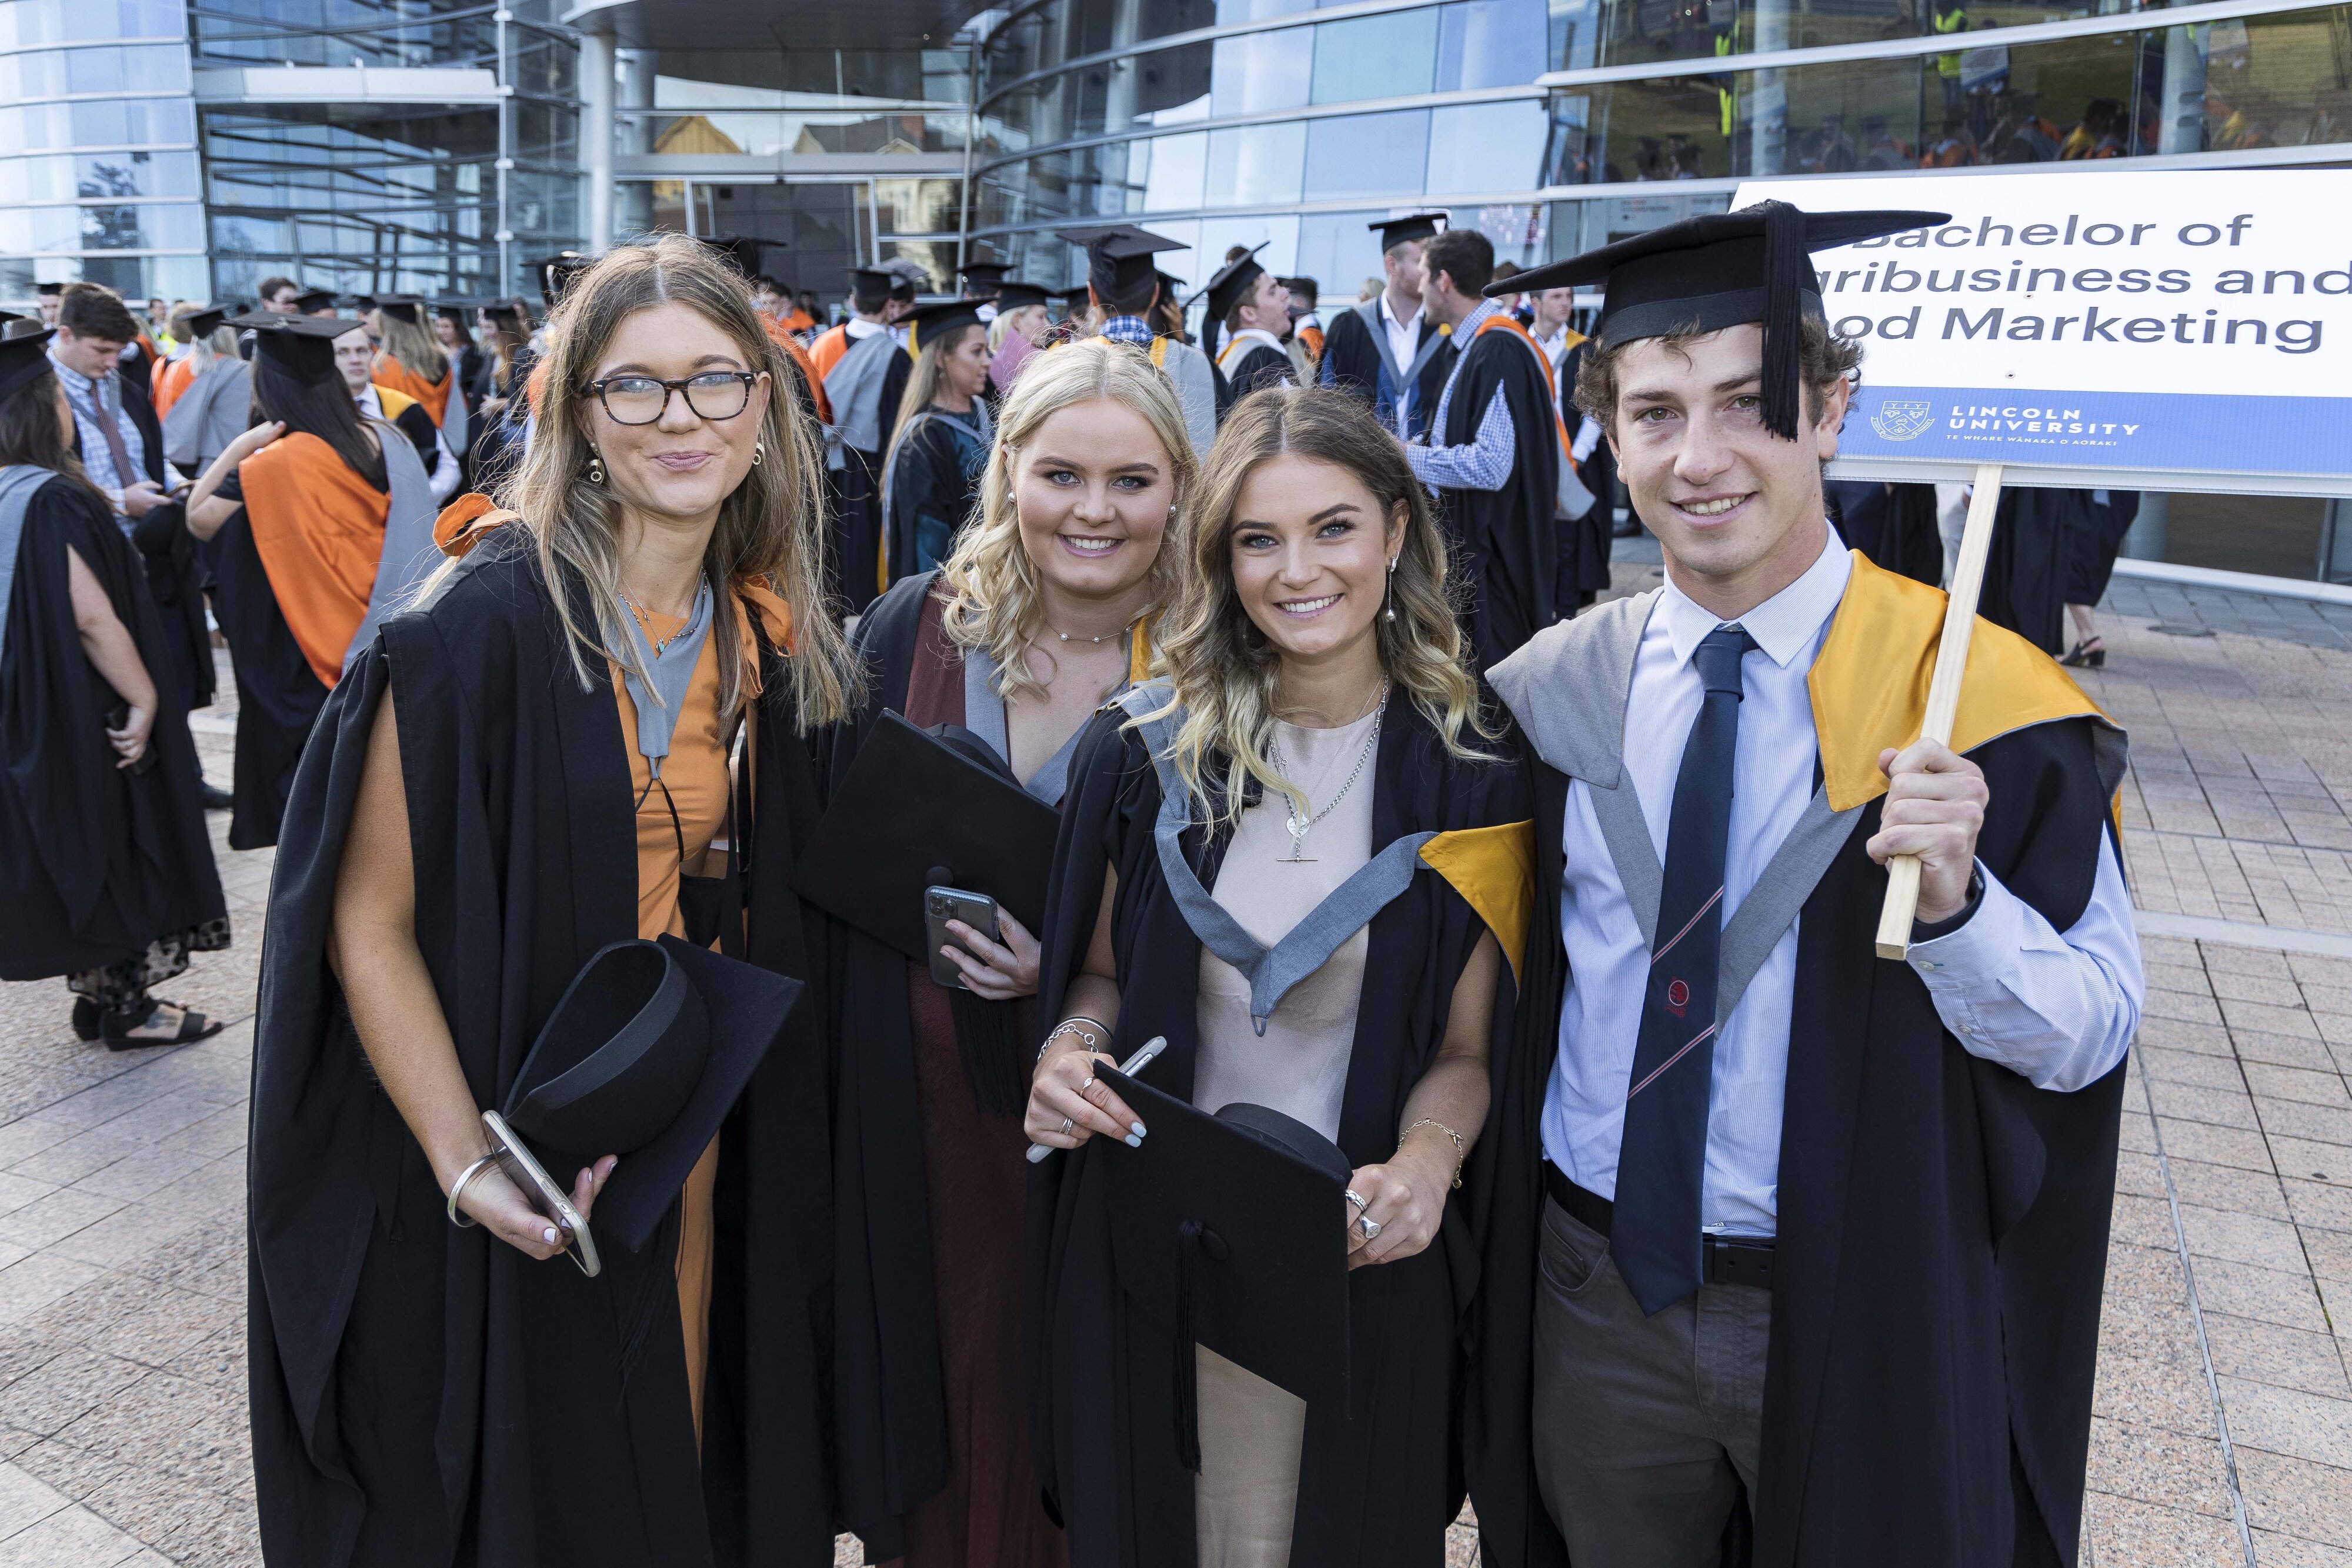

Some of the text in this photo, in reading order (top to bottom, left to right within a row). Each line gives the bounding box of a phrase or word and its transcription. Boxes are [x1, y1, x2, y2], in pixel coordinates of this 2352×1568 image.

[2178, 214, 2254, 246] of
[1814, 259, 2352, 296] ribusiness and
[1833, 306, 2323, 354] od Marketing
[1949, 418, 2140, 435] UNIVERSITY
[1951, 406, 2080, 420] LINCOLN
